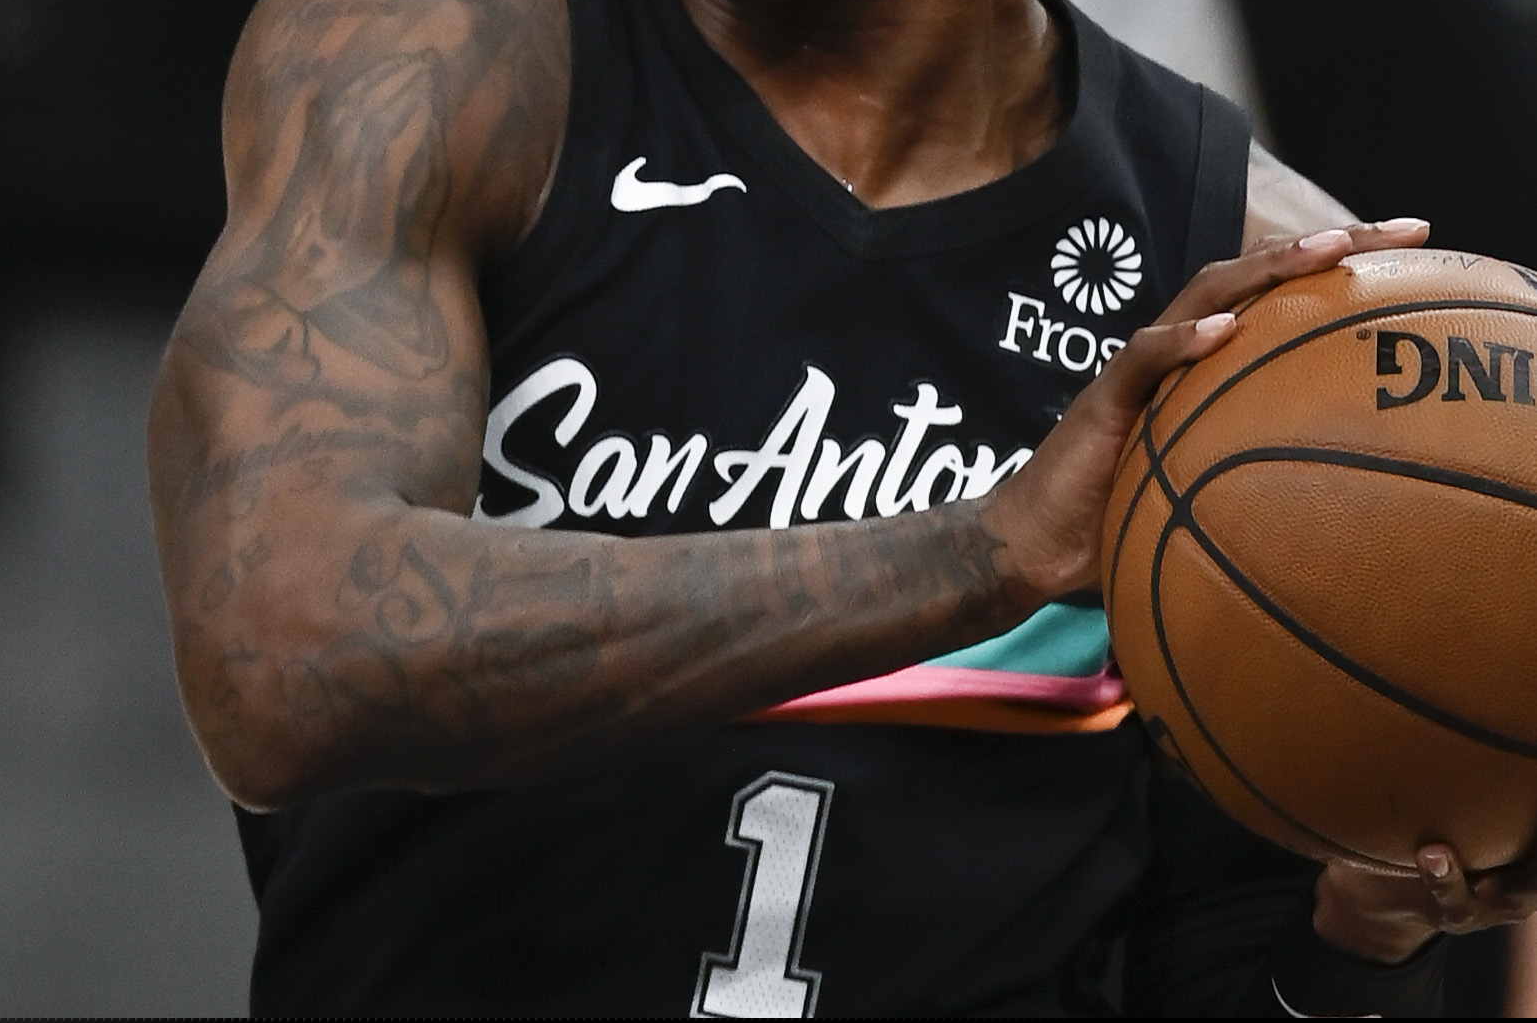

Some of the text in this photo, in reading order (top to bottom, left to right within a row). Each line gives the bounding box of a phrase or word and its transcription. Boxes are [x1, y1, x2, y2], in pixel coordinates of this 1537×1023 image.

[471, 357, 1063, 530] San Anton
[689, 769, 835, 1018] 1
